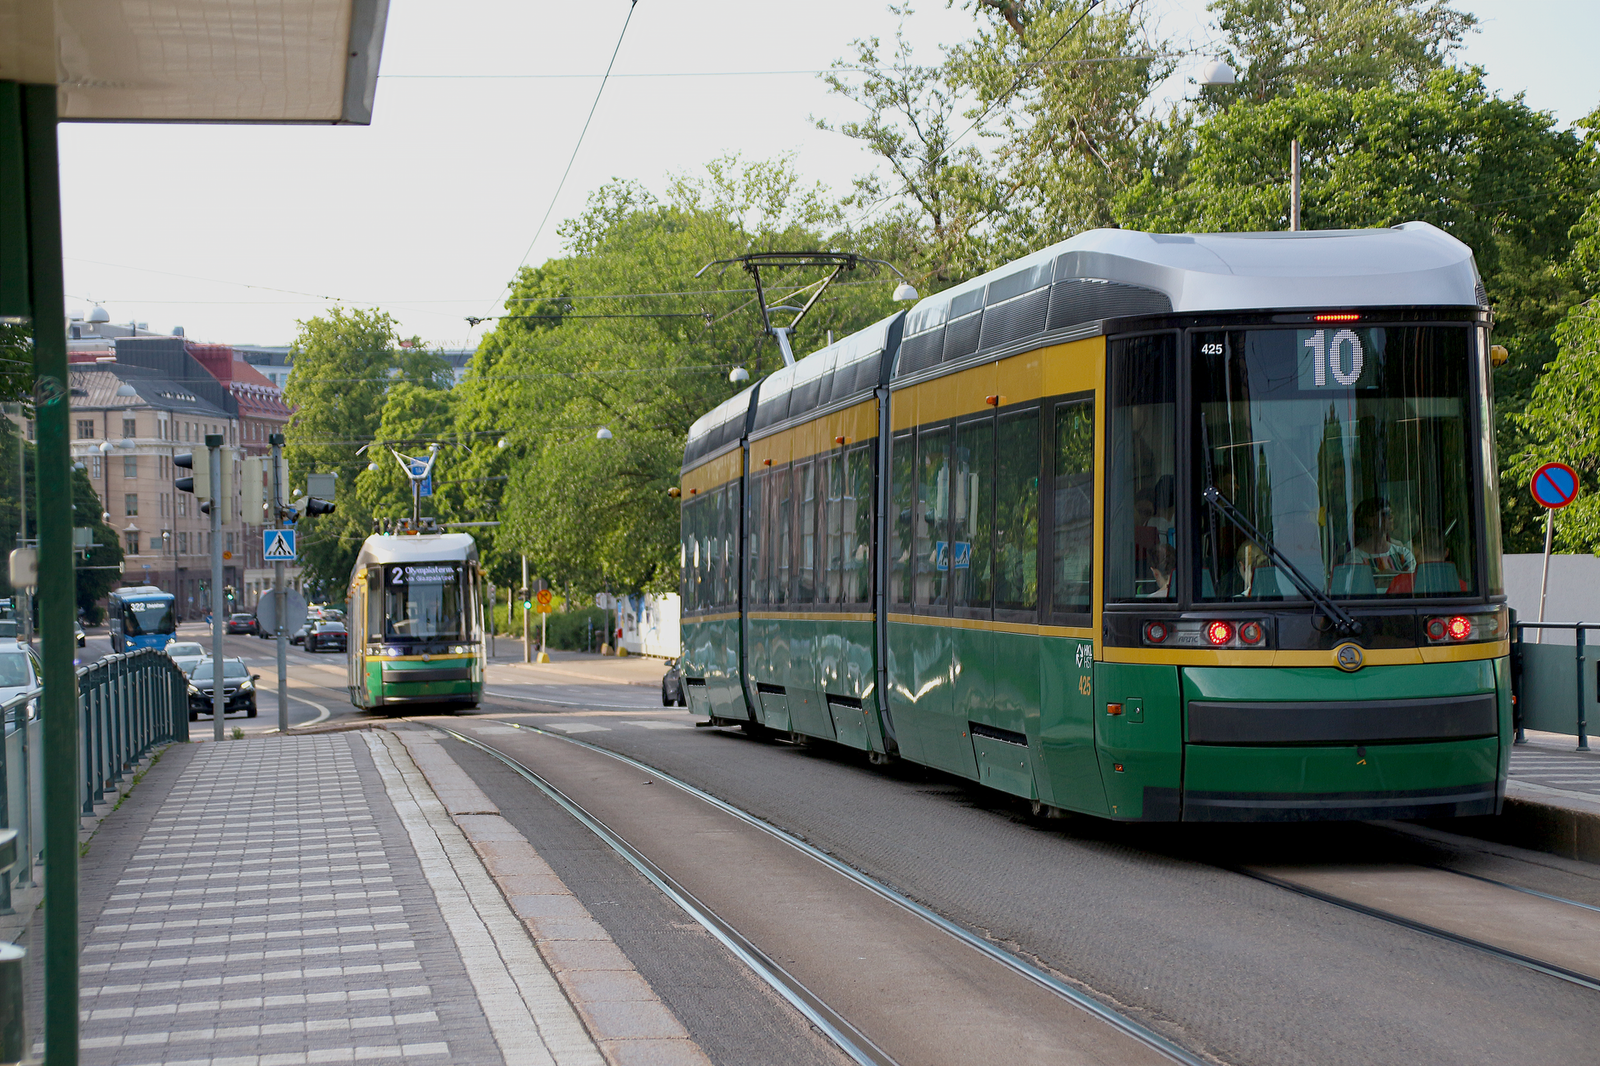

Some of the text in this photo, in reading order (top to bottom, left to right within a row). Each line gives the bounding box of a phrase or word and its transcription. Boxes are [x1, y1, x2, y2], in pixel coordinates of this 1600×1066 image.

[1201, 343, 1223, 355] 425
[1304, 329, 1363, 386] 10
[392, 566, 403, 584] 2
[130, 602, 146, 612] 322
[1079, 675, 1091, 696] 425
